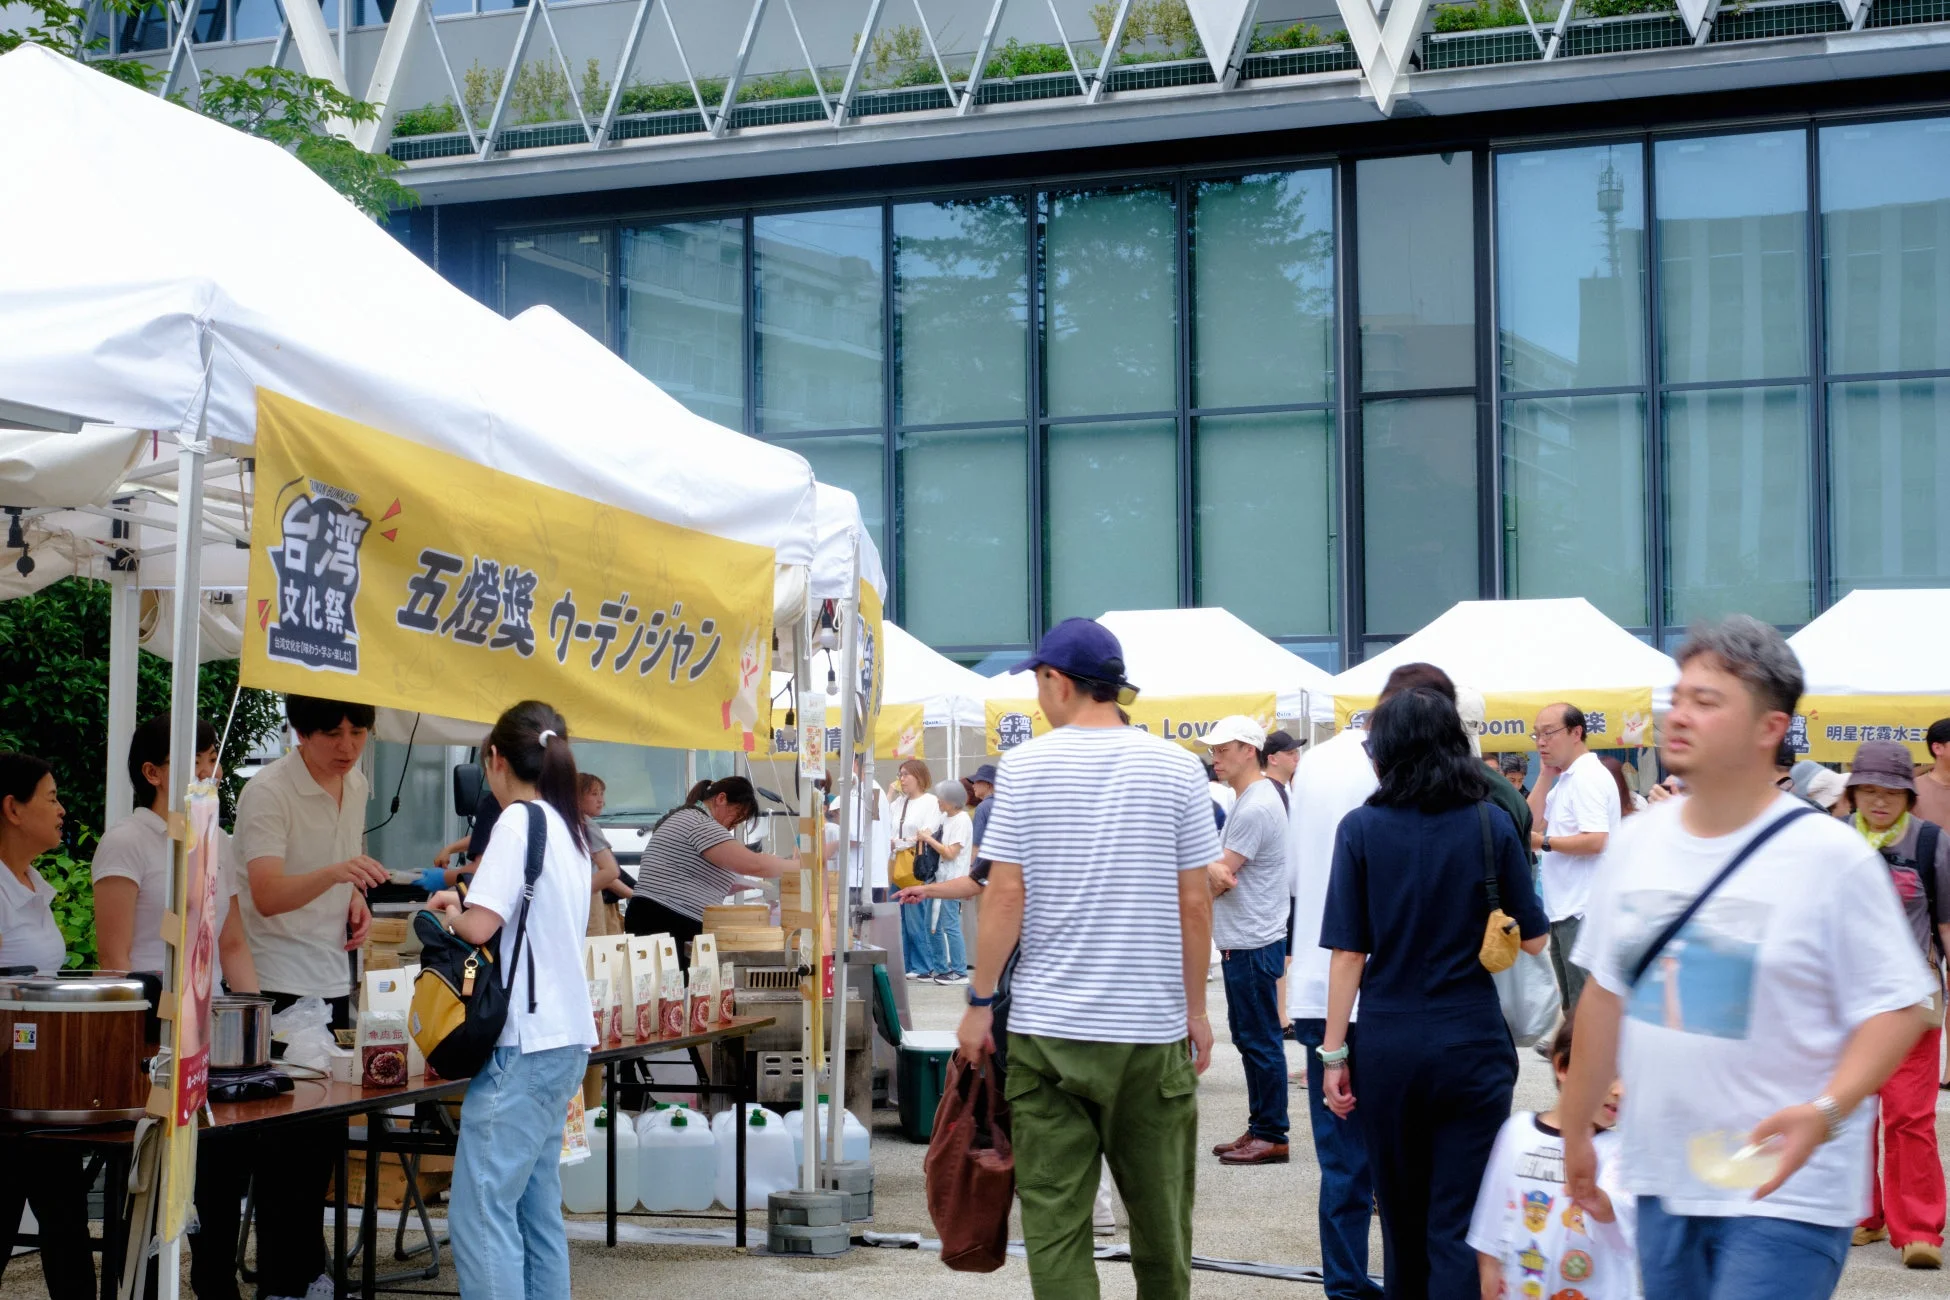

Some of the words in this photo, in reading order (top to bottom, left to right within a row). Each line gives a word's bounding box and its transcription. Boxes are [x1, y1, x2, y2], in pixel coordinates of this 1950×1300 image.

[283, 494, 369, 586] 台湾
[281, 578, 347, 635] 文化祭
[551, 591, 721, 682] ウーデンジャン
[999, 716, 1031, 733] 台湾
